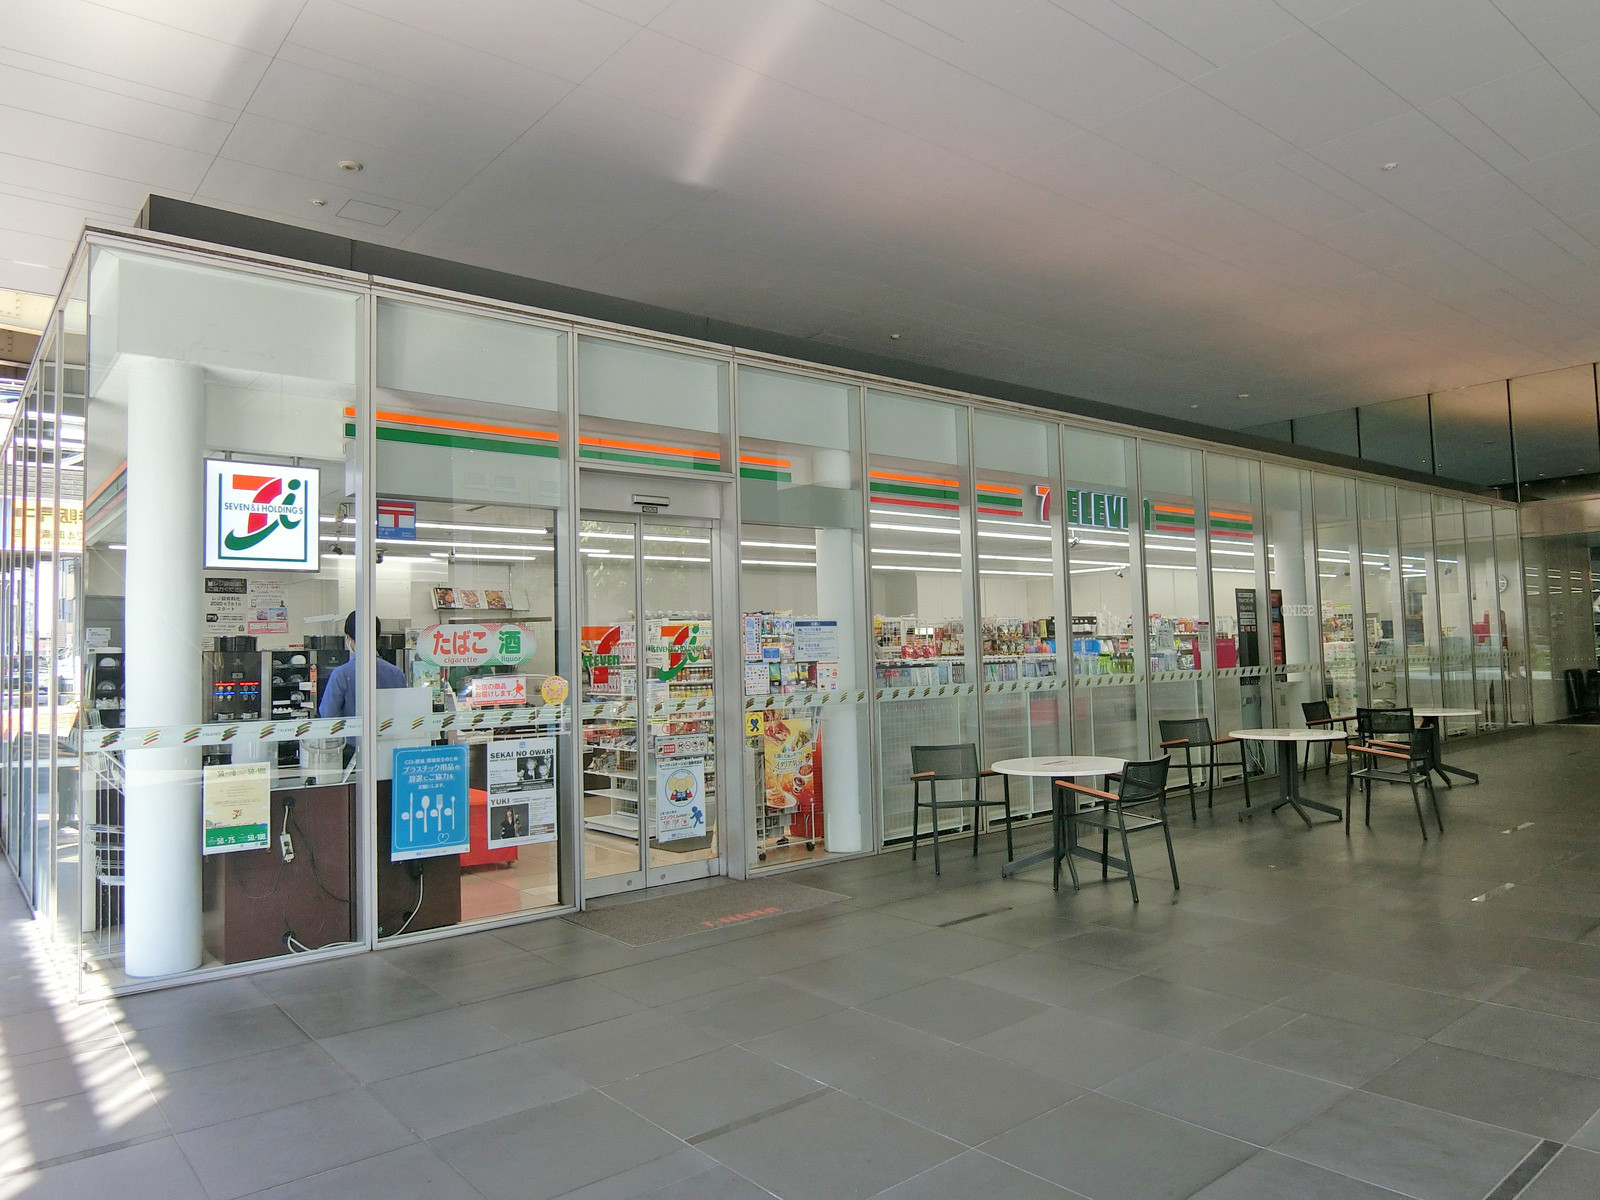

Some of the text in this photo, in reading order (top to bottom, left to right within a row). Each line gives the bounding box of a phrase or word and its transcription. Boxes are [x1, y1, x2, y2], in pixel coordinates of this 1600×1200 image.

[262, 504, 303, 515] HOLDINGS
[433, 629, 521, 656] たばこ 酒
[443, 655, 522, 665] cigarette liquor
[475, 682, 507, 691] お店の商品
[489, 751, 514, 760] SEKAI
[529, 748, 554, 756] OWARI
[402, 763, 461, 774] プラスチック用品の
[408, 773, 454, 783] 辞退にご協力を
[490, 798, 510, 806] YUKI
